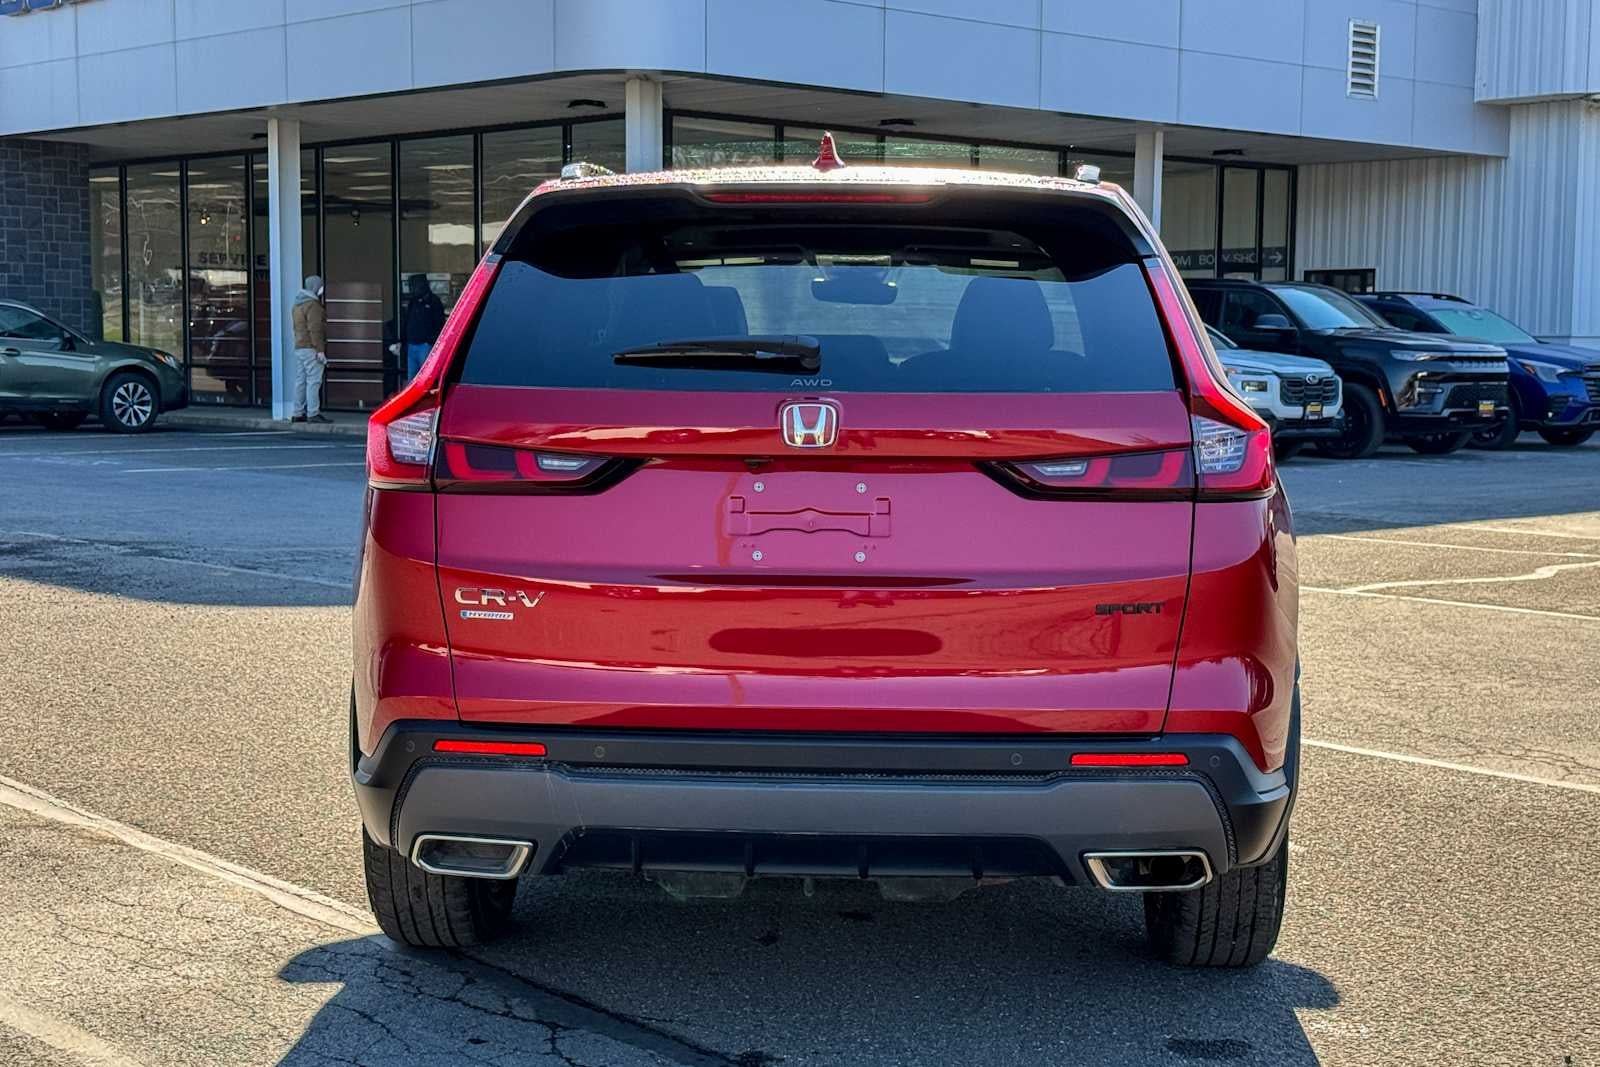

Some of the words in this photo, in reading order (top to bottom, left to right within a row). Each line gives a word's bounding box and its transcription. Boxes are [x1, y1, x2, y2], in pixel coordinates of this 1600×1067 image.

[198, 252, 267, 266] SERVIE
[1199, 253, 1230, 266] BOY
[1231, 252, 1265, 264] SHO
[790, 378, 833, 387] AWD
[454, 586, 545, 608] CR-V
[1095, 601, 1166, 616] SPORT
